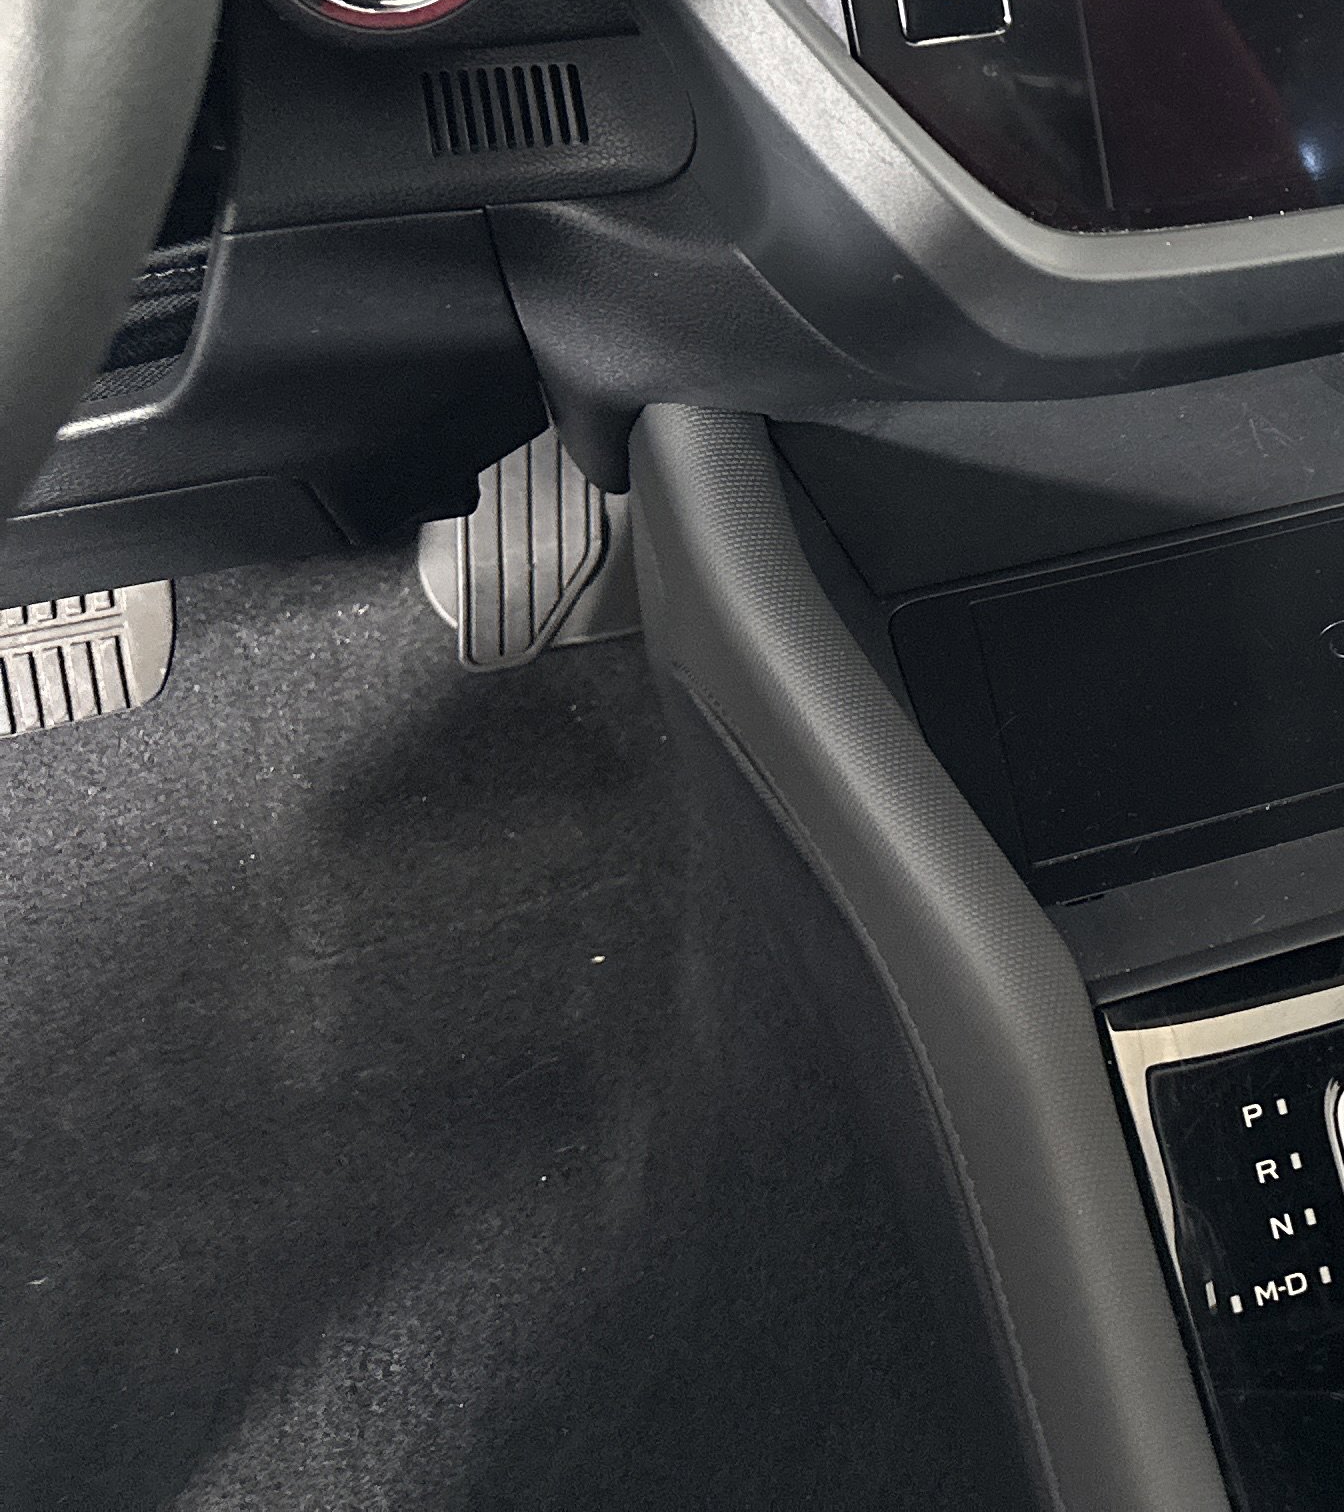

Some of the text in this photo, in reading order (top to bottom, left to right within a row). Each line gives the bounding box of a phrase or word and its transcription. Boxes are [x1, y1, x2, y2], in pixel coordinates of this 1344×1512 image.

[1241, 1103, 1263, 1128] P
[1255, 1158, 1279, 1184] R
[1269, 1213, 1294, 1240] N
[1253, 1272, 1308, 1307] M-D
